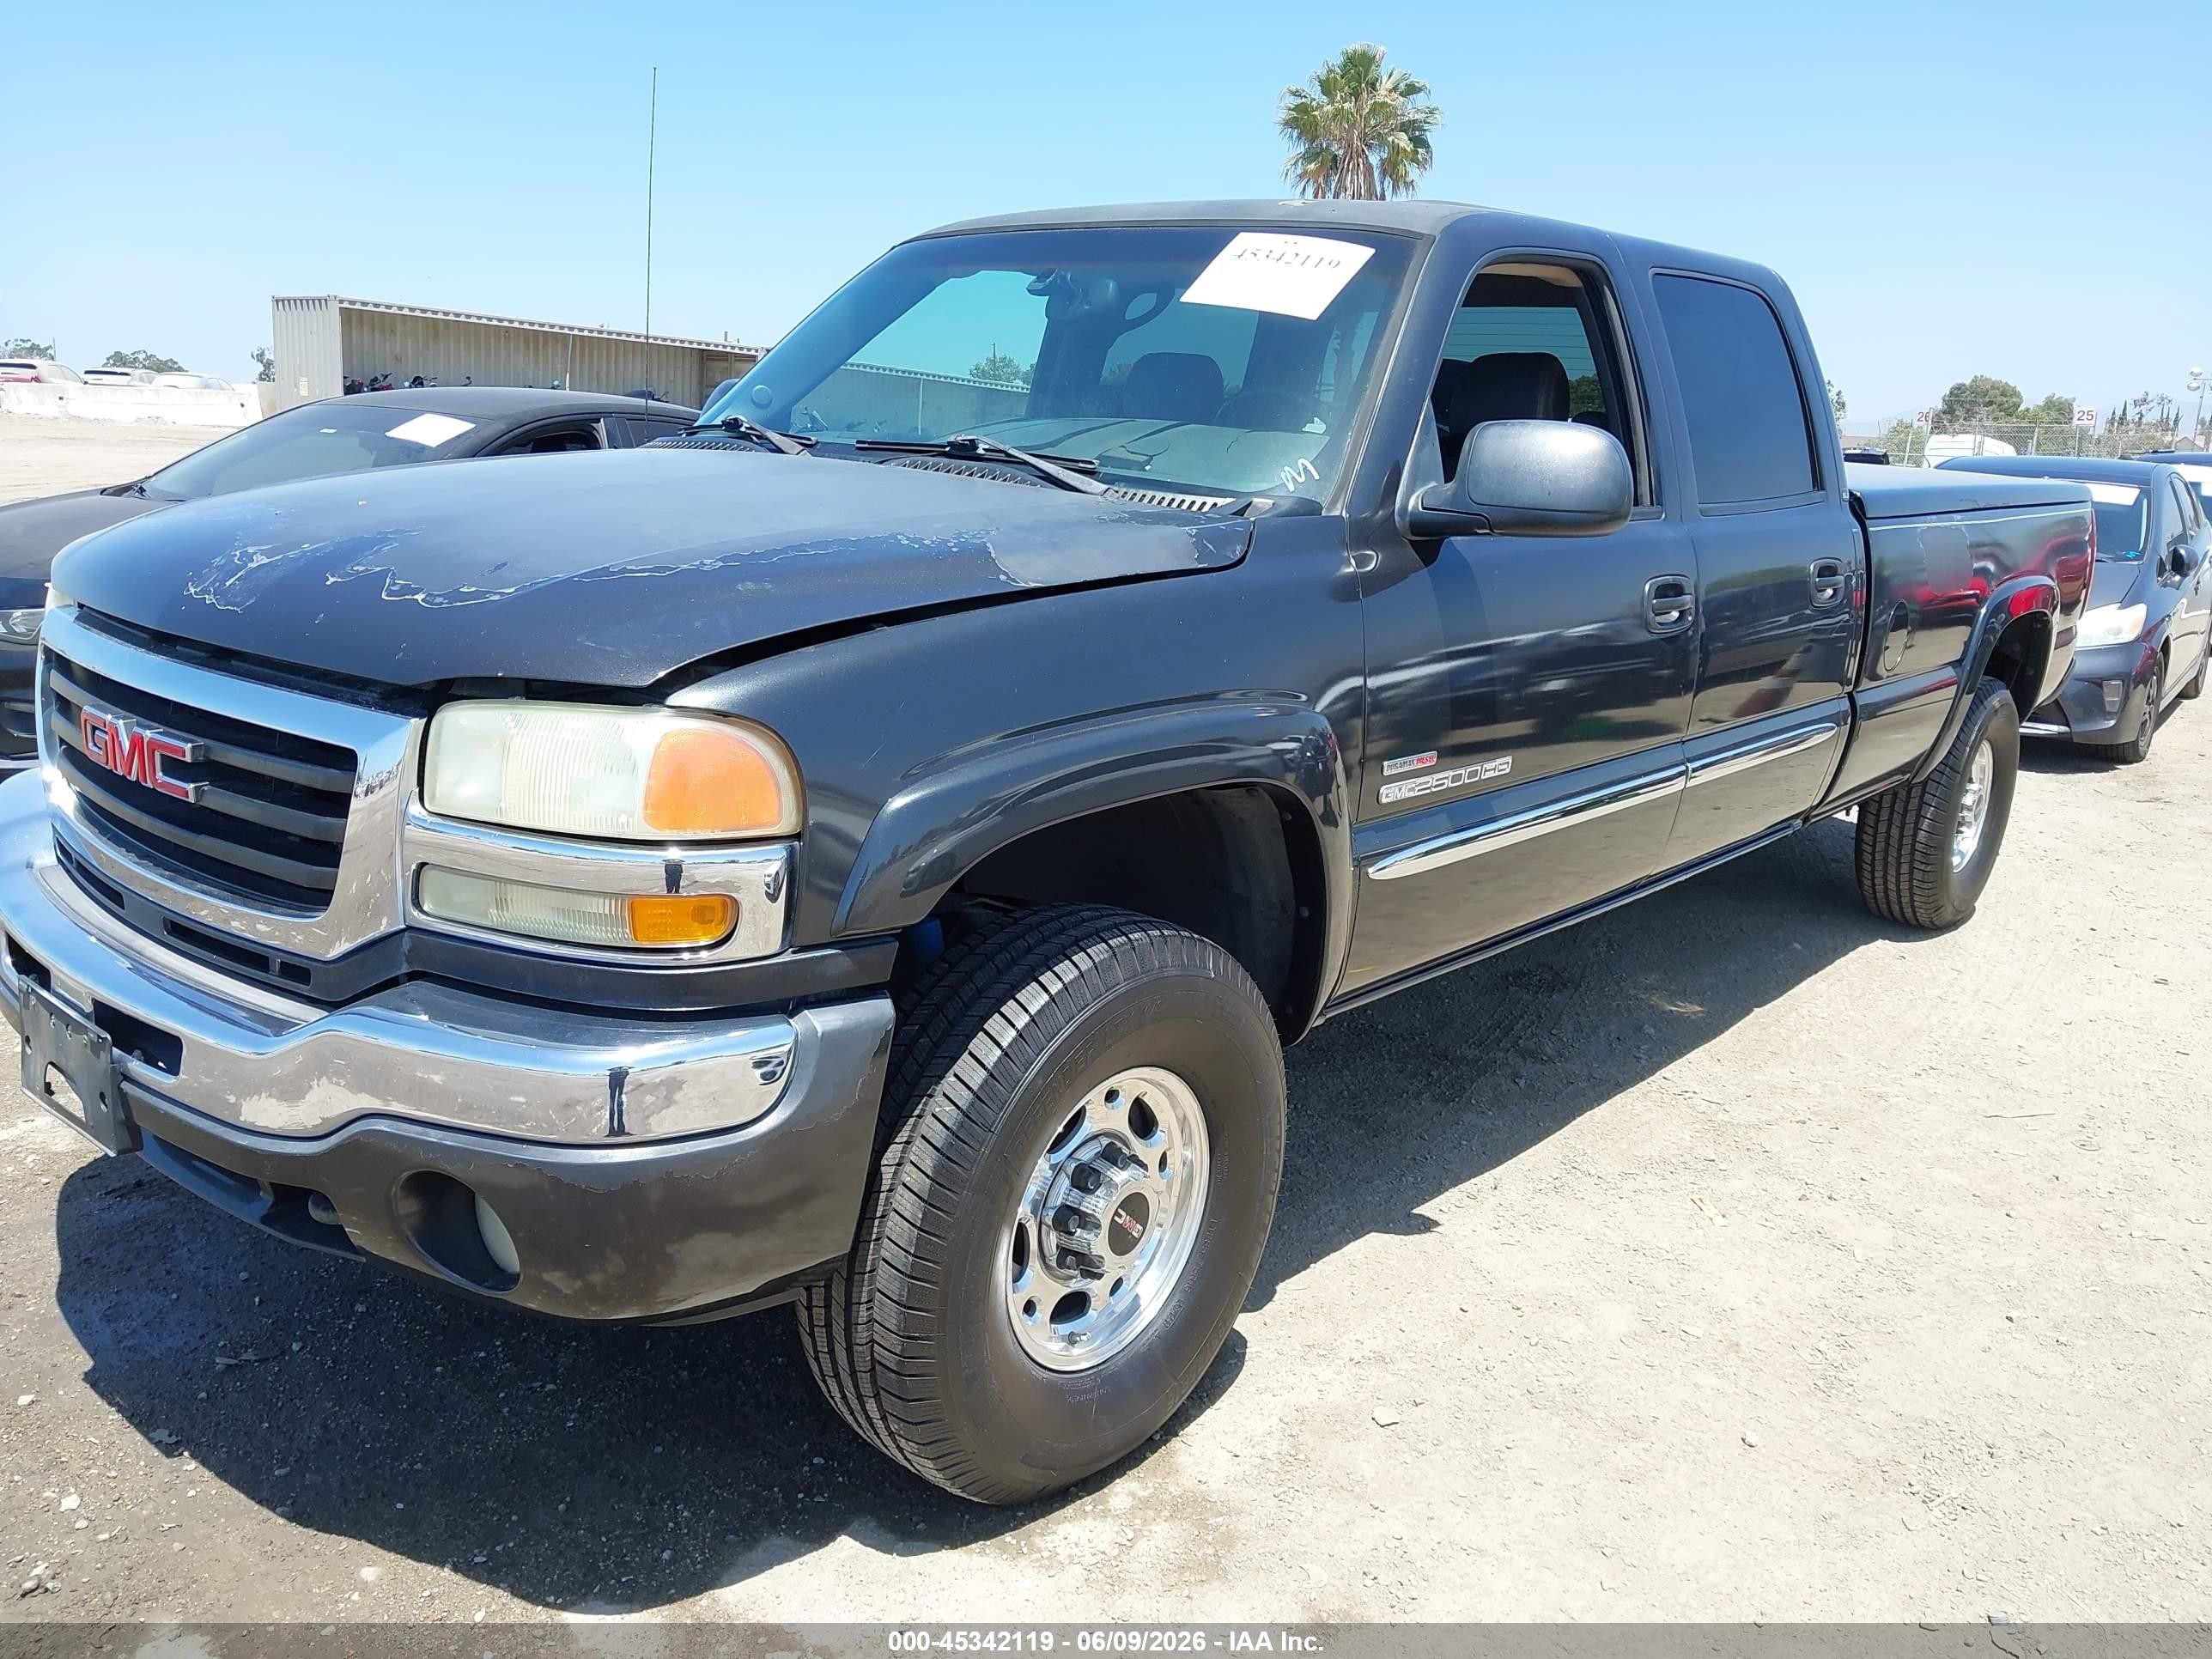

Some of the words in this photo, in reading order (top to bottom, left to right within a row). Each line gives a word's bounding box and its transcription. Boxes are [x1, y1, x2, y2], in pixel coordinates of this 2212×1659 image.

[2076, 410, 2095, 422] 25
[81, 705, 204, 804] GMC
[1415, 754, 1437, 767] DIESEL
[1114, 1207, 1144, 1238] GMC
